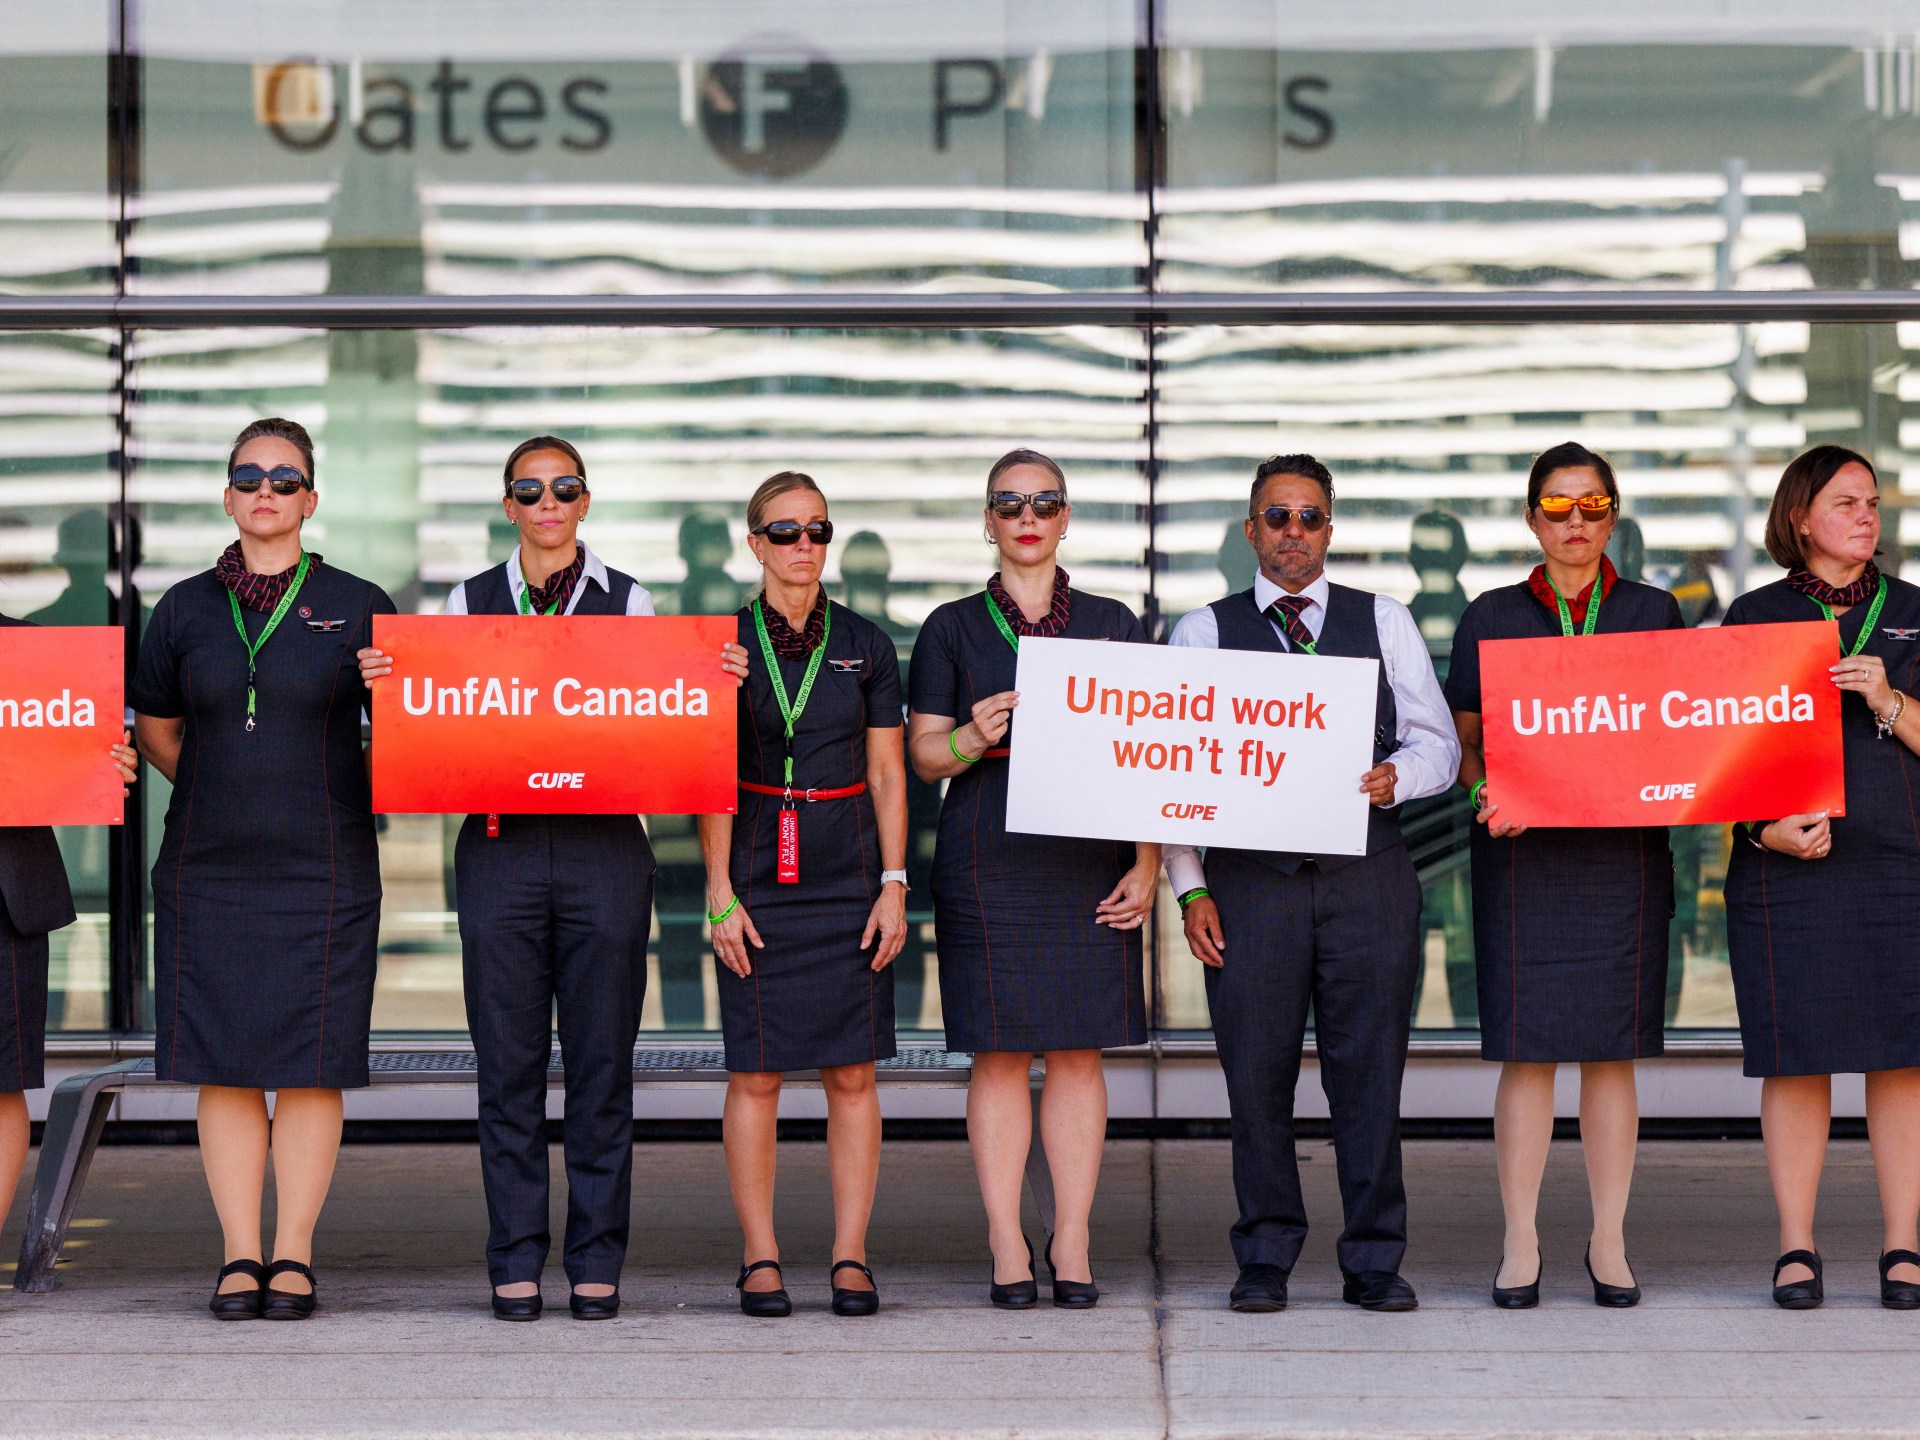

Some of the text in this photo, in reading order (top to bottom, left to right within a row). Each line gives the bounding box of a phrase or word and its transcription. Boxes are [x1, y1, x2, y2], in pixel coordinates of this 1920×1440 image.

[0, 689, 95, 728] nada
[402, 677, 709, 717] UnfAir Canada
[795, 688, 809, 711] More
[1066, 675, 1328, 731] Unpaid work
[790, 709, 801, 722] No
[1511, 684, 1815, 736] UnfAir Canada
[1238, 739, 1287, 788] fly
[527, 772, 586, 789] CUPE
[1639, 783, 1697, 802] CUPE
[1160, 802, 1218, 821] CUPE
[781, 848, 790, 865] FLY
